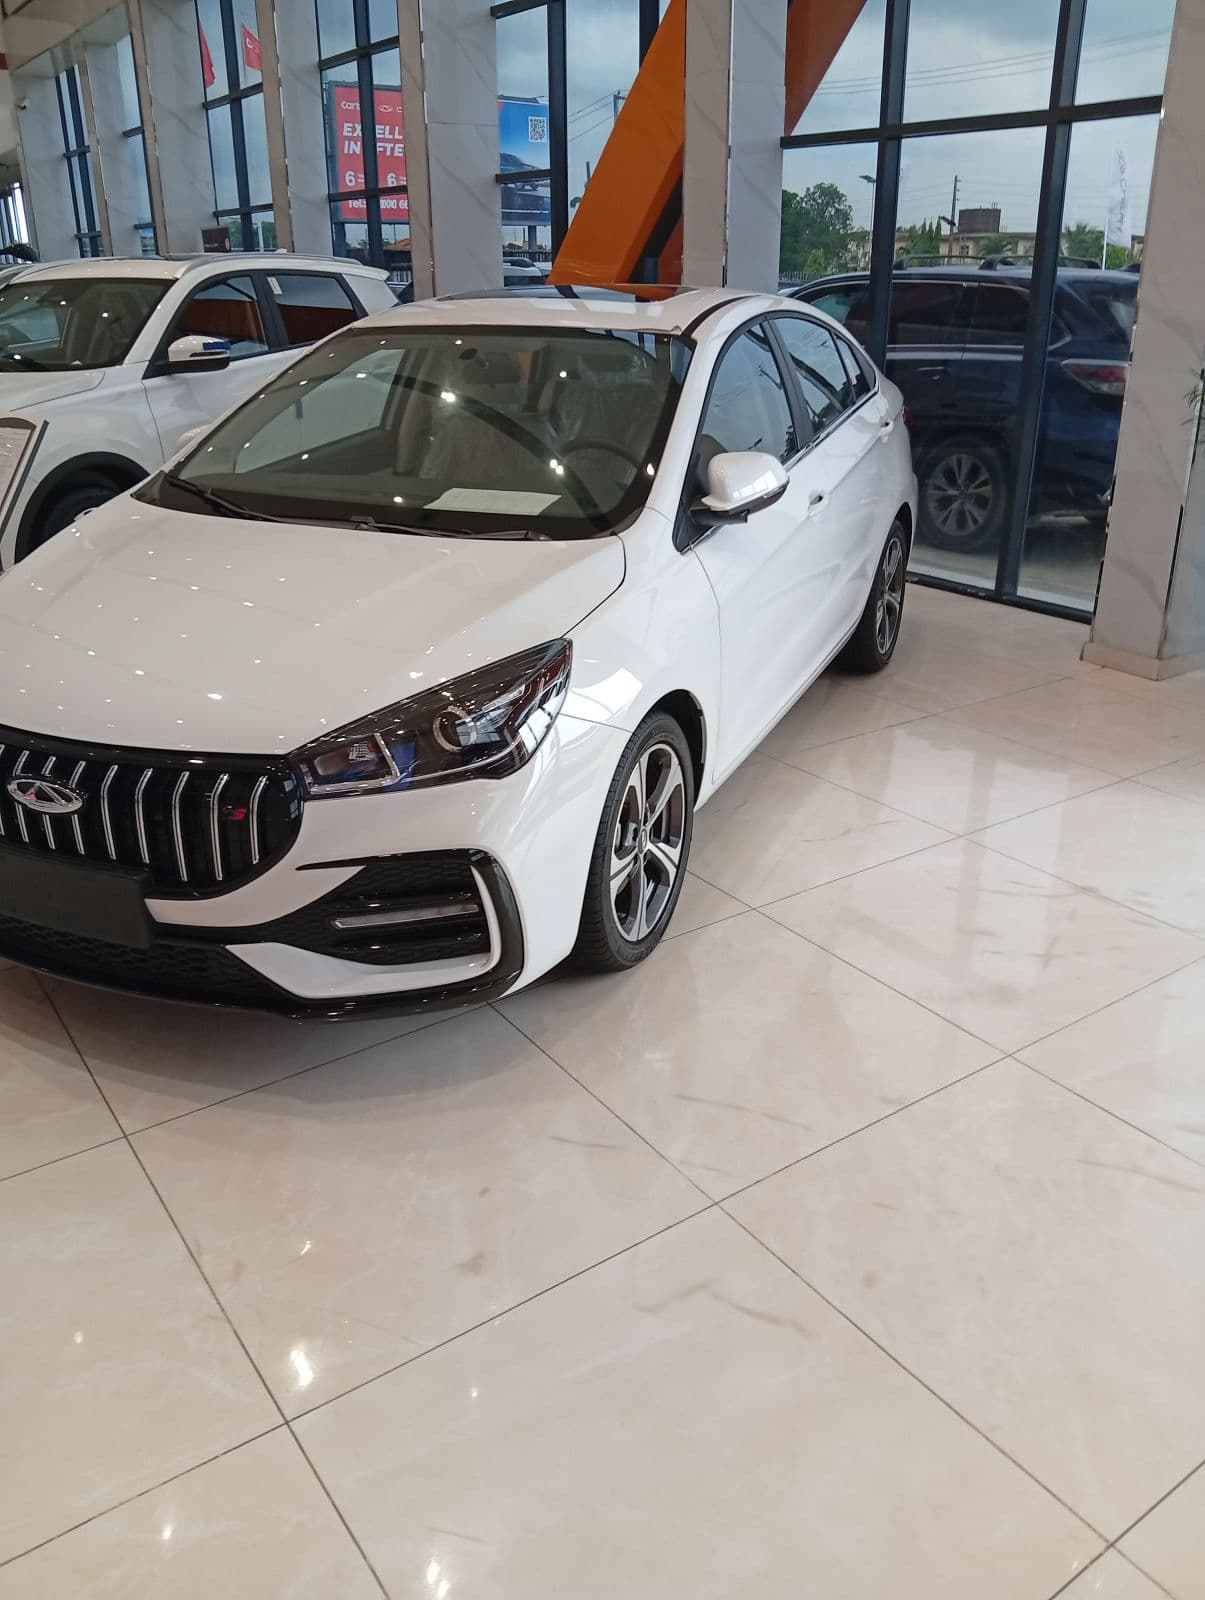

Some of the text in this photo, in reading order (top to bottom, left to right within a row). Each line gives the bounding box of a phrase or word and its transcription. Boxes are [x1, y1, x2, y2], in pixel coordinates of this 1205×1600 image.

[344, 140, 361, 155] IN
[345, 170, 356, 187] 6
[387, 173, 397, 187] 6
